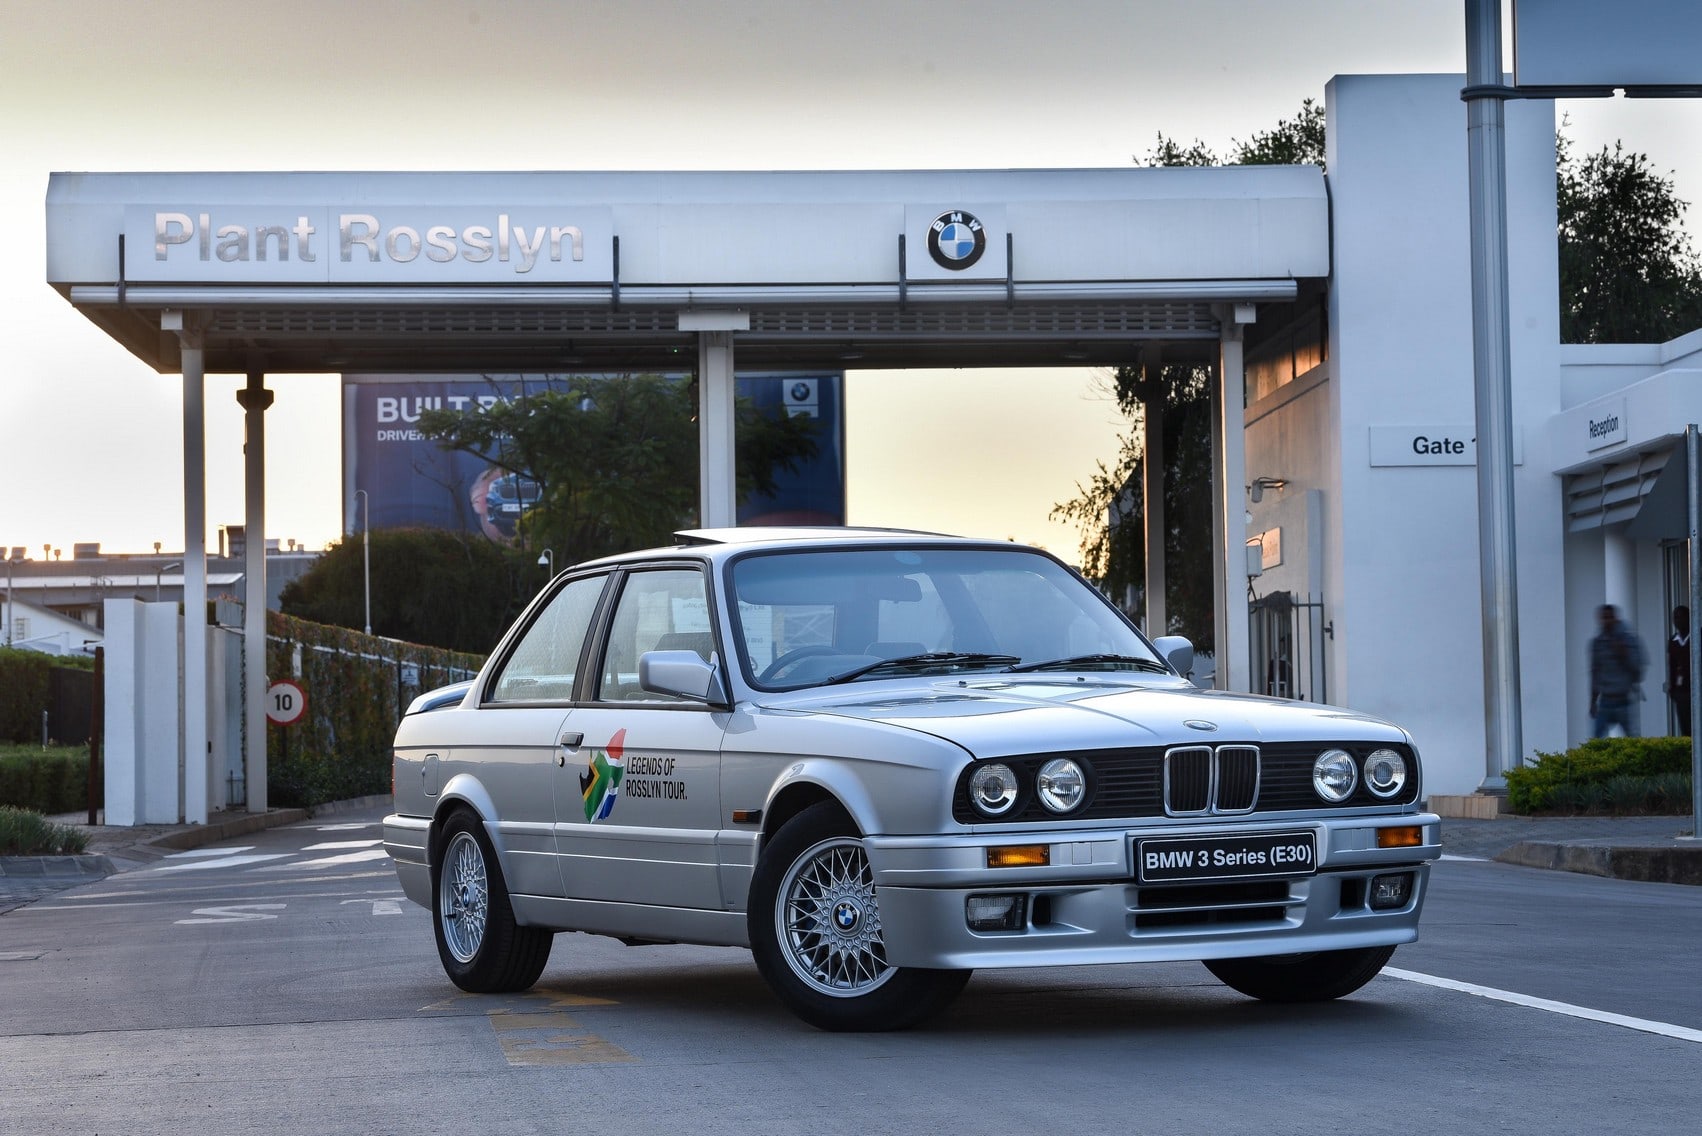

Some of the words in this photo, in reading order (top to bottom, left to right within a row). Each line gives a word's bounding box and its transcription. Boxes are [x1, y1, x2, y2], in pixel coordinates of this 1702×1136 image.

[932, 213, 982, 232] BMW
[155, 213, 316, 262] Plant
[340, 214, 583, 273] Rosslyn
[1589, 413, 1619, 440] Reception
[1413, 436, 1465, 455] Gate
[275, 694, 293, 711] 10
[626, 757, 663, 776] LEGENDS
[664, 758, 676, 776] OF
[626, 779, 661, 798] ROSSLYN
[662, 781, 688, 800] TOUR.
[1146, 850, 1194, 869] BMW
[1198, 850, 1209, 867] 3
[1213, 848, 1266, 866] Series
[1270, 844, 1312, 866] (E30)
